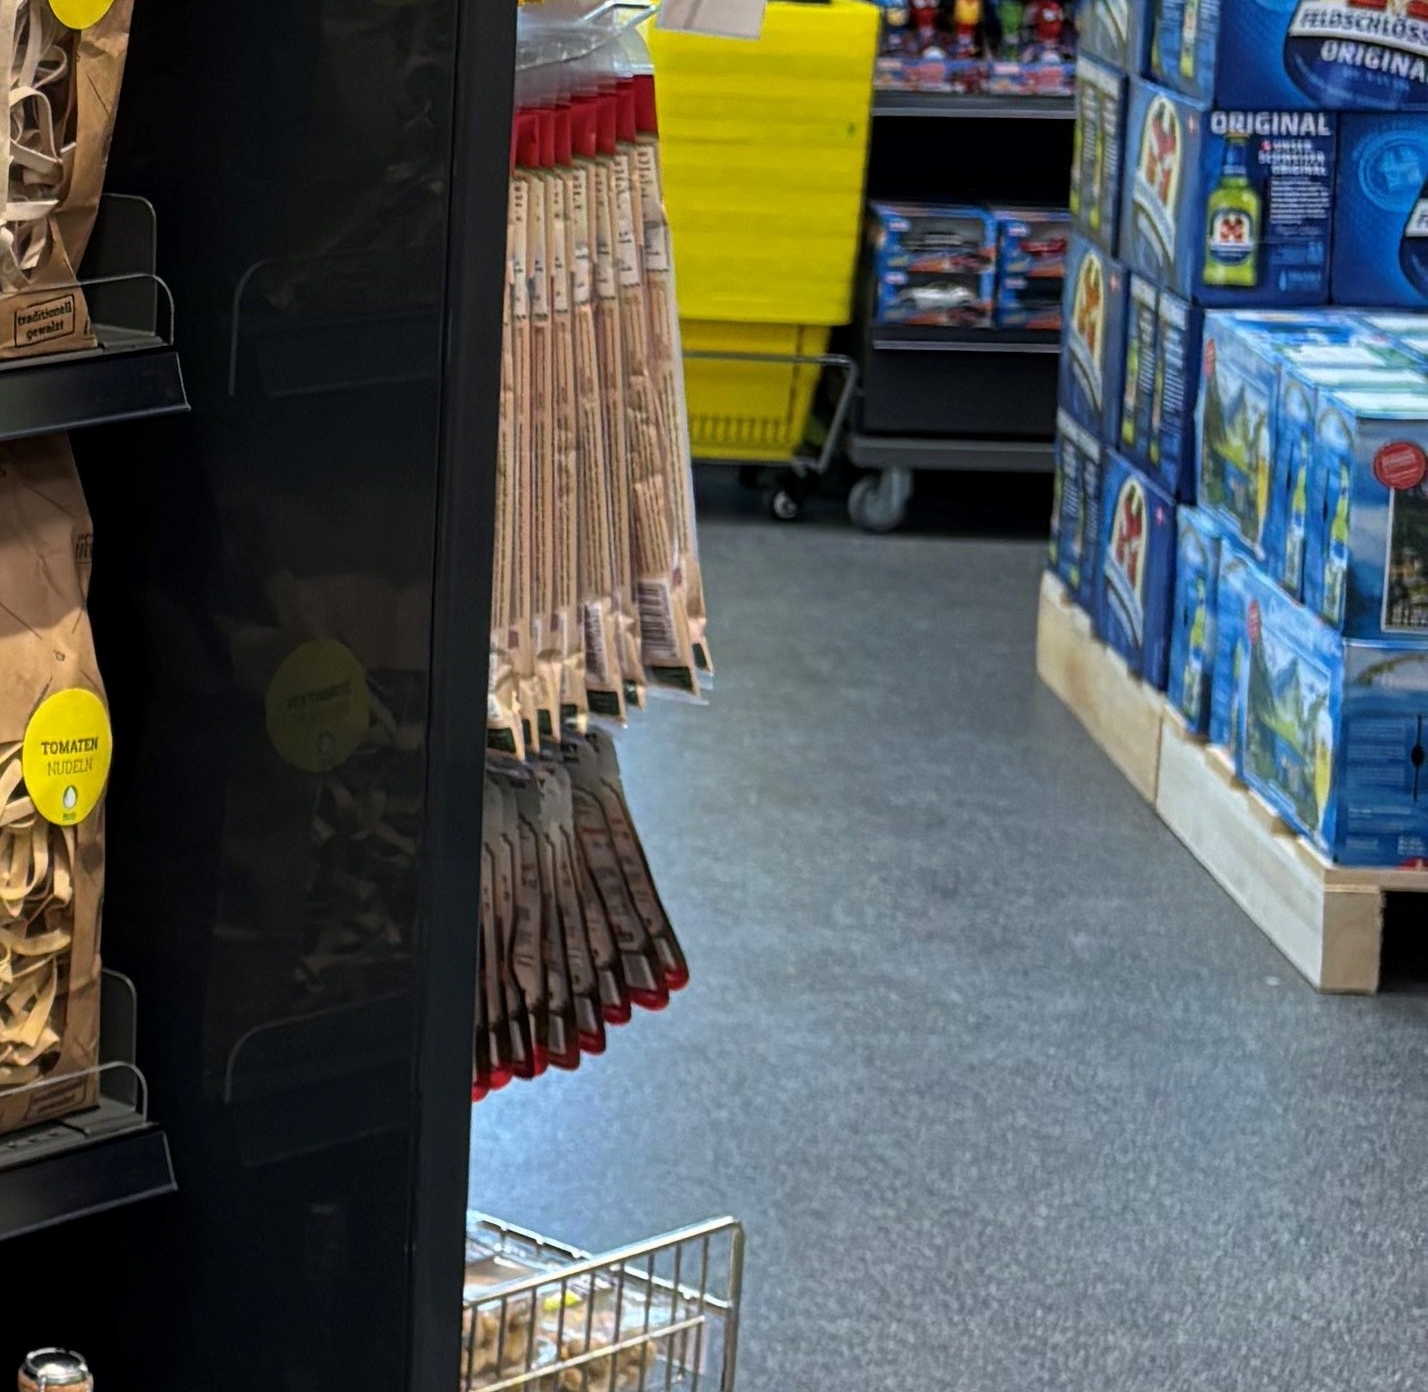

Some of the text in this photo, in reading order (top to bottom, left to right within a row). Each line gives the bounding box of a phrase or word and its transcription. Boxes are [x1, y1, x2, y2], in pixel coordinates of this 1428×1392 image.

[1321, 40, 1428, 84] ORIGINA
[1211, 111, 1332, 136] ORIGINAL
[16, 301, 73, 327] traditionell
[41, 737, 99, 756] TOMATEN
[47, 759, 93, 777] NUDELN
